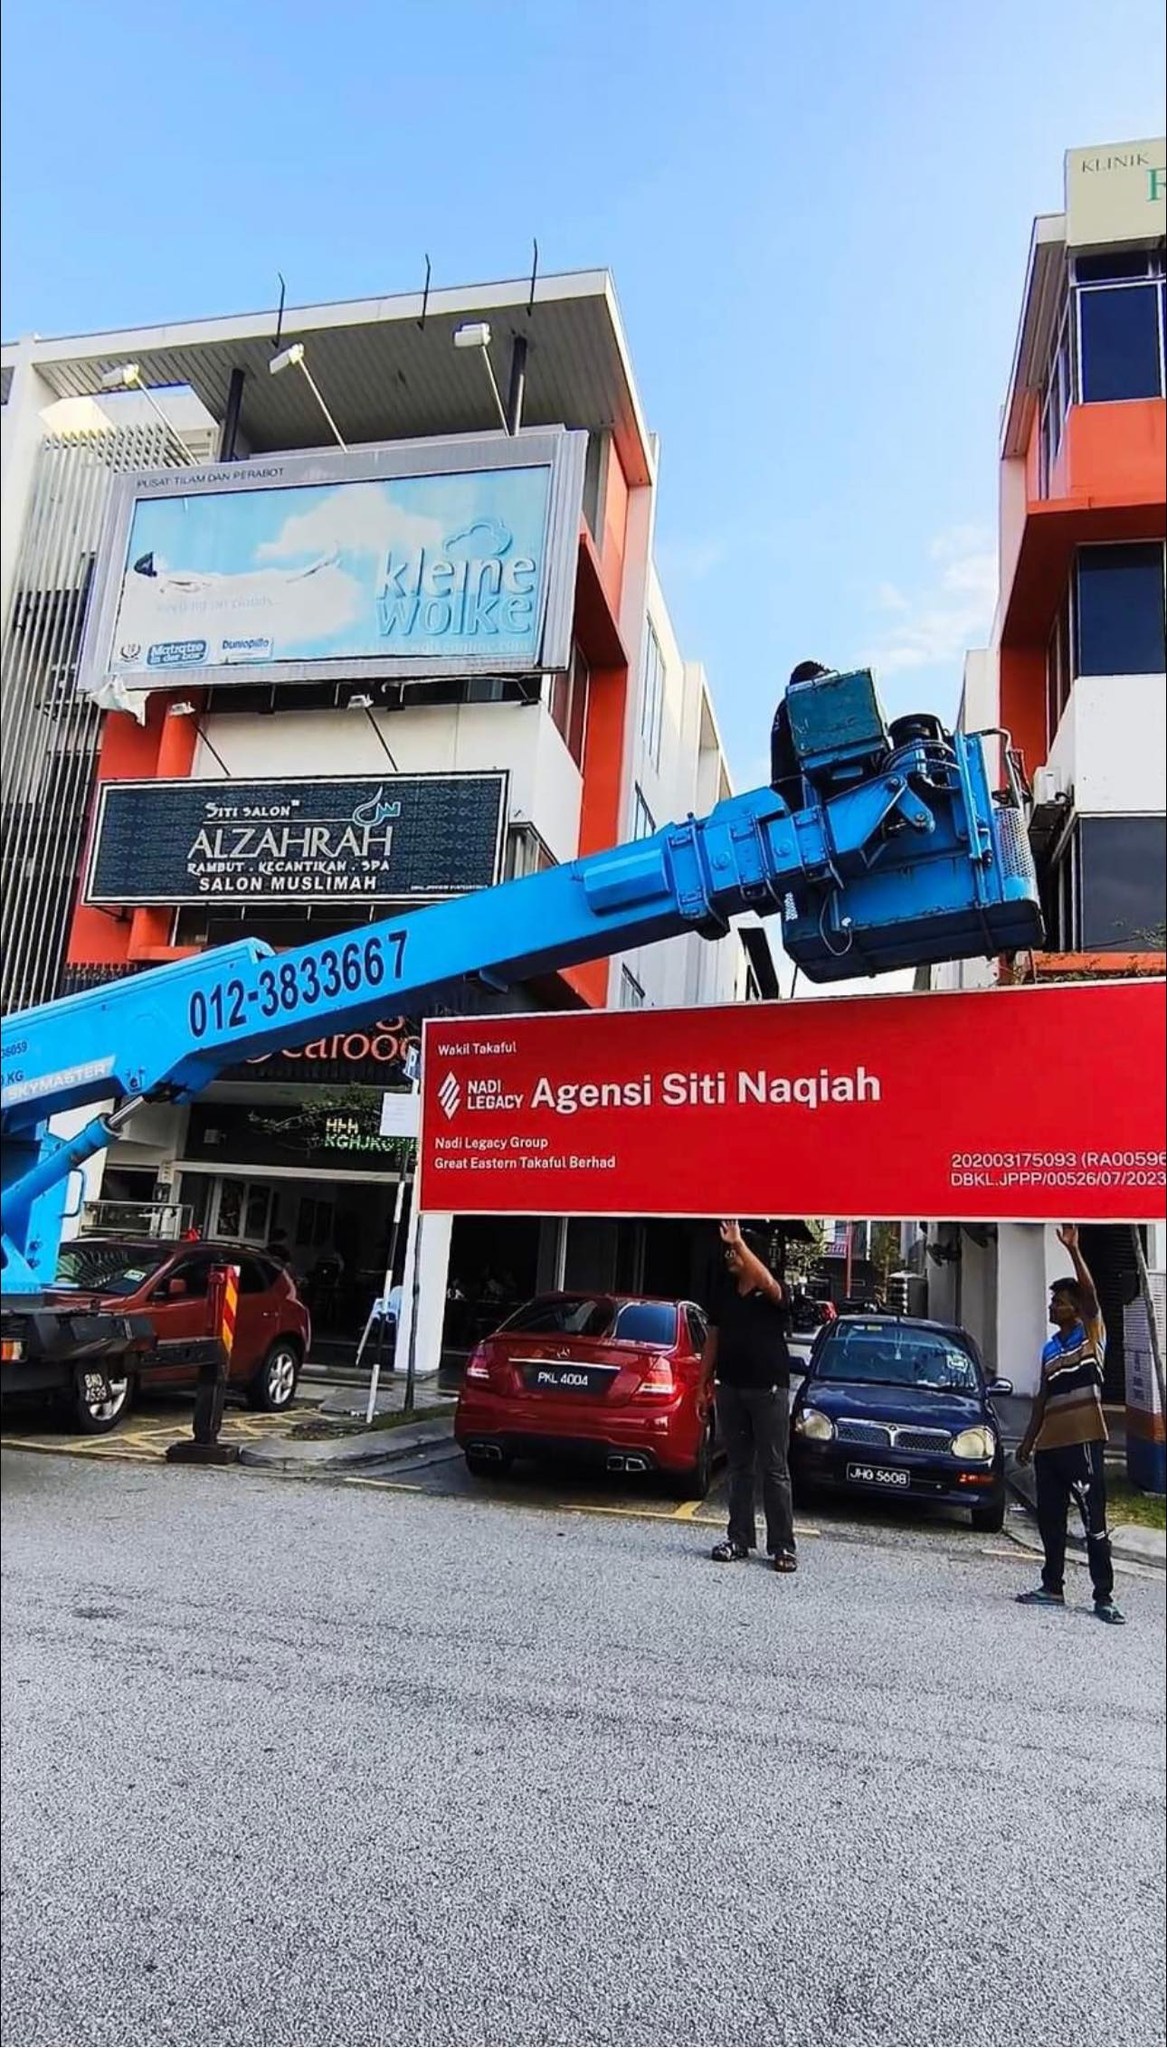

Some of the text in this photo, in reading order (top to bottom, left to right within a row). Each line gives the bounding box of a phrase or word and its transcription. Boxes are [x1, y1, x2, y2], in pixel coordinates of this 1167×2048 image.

[1082, 154, 1149, 173] KLINIK
[136, 479, 171, 489] PUSAT
[207, 473, 231, 483] DAN
[233, 467, 285, 480] PERABOT
[377, 547, 536, 599] kleine
[376, 595, 534, 636] wolke
[187, 826, 393, 860] ALZAHRAH
[187, 860, 390, 875] RAMBUT KECANTIKAN SPA
[199, 875, 377, 891] SALON MUSLIMAH
[189, 929, 408, 1038] 012-3833667
[437, 1041, 517, 1056] Wakil Takaful
[7, 1062, 108, 1101] SKYMASTER
[467, 1080, 501, 1094] NADI
[530, 1066, 882, 1114] Agensi Siti Naqiah
[467, 1094, 524, 1110] LEGACY
[435, 1136, 549, 1150] Nadi Legacy Group
[435, 1155, 616, 1169] Great Eastern Takaful Berhad
[952, 1153, 1077, 1168] 202003175093
[537, 1371, 589, 1386] PKL 4004
[875, 1470, 907, 1484] 5608
